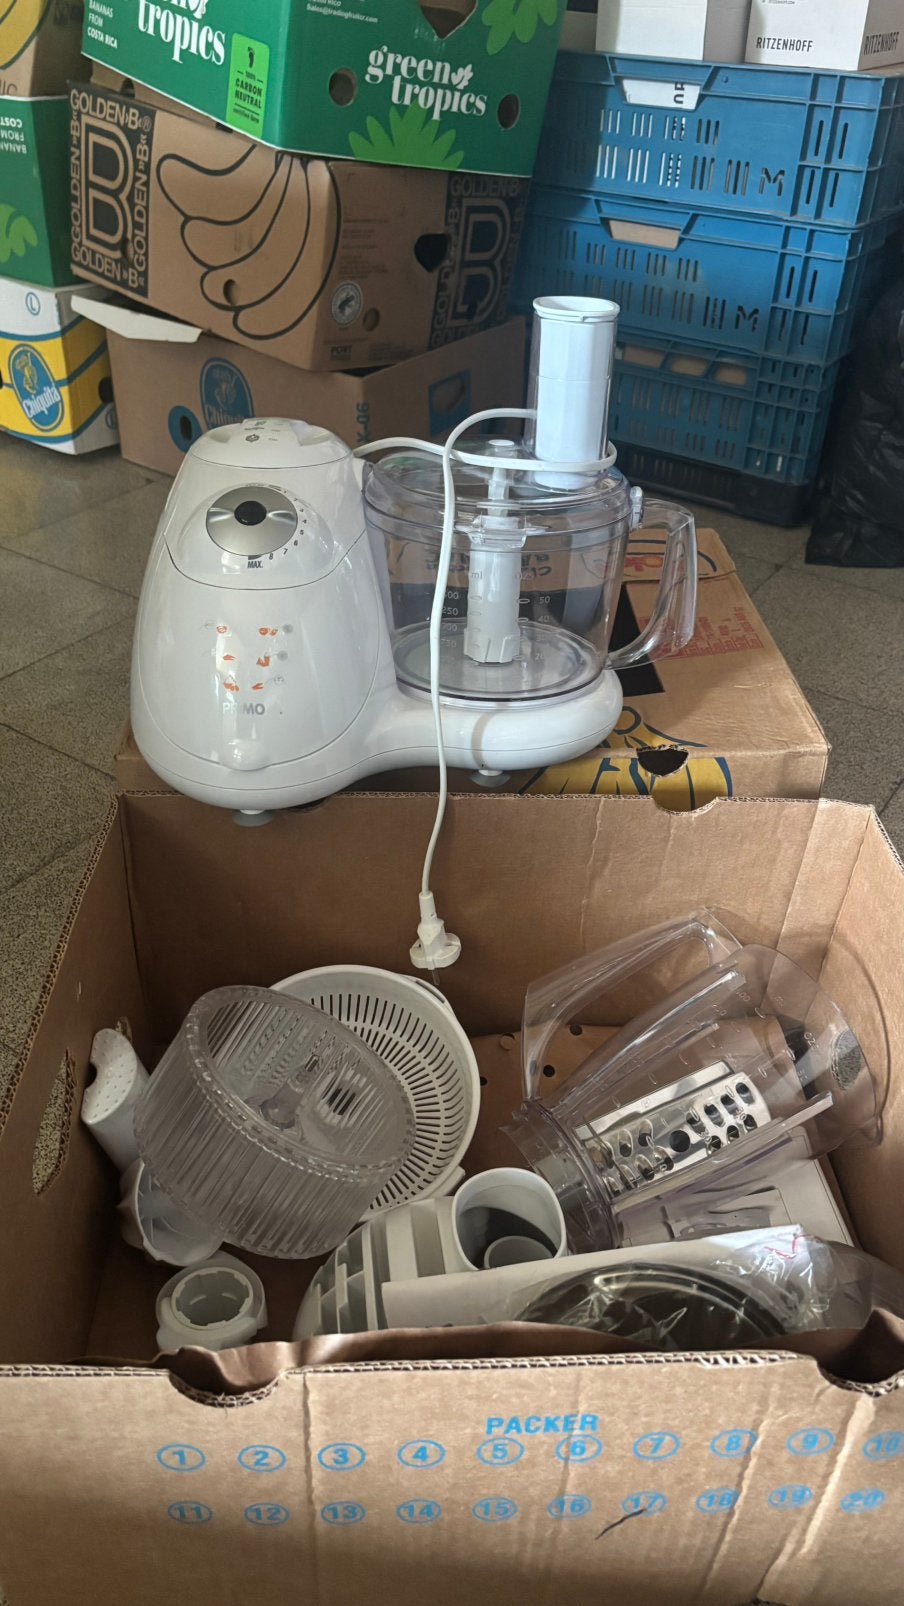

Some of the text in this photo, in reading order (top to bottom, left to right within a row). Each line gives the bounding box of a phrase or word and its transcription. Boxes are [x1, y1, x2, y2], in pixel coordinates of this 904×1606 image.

[87, 26, 118, 49] COSTA RICA
[137, 0, 225, 66] tropics
[756, 36, 813, 53] RITZENHOFF
[863, 31, 900, 55] RITZENHOFF
[364, 45, 451, 84] green
[234, 89, 262, 109] NEUTRAL
[235, 78, 263, 98] CARBON
[391, 74, 488, 121] tropics
[22, 385, 60, 418] Chiquita
[486, 1413, 600, 1436] PACKER
[172, 1450, 186, 1466] 1
[252, 1450, 271, 1467] 2
[332, 1447, 350, 1466] 3
[412, 1445, 430, 1462] 4
[491, 1443, 509, 1460] 5
[569, 1440, 587, 1457] 6
[649, 1437, 666, 1454] 7
[725, 1435, 742, 1452] 8
[802, 1433, 819, 1450] 9
[174, 1506, 203, 1520] 11
[250, 1507, 282, 1521] 12
[326, 1506, 358, 1520] 13
[402, 1504, 434, 1518] 14
[481, 1502, 510, 1517] 15
[555, 1499, 586, 1514] 16
[630, 1493, 660, 1510] 17
[848, 1490, 881, 1508] 20
